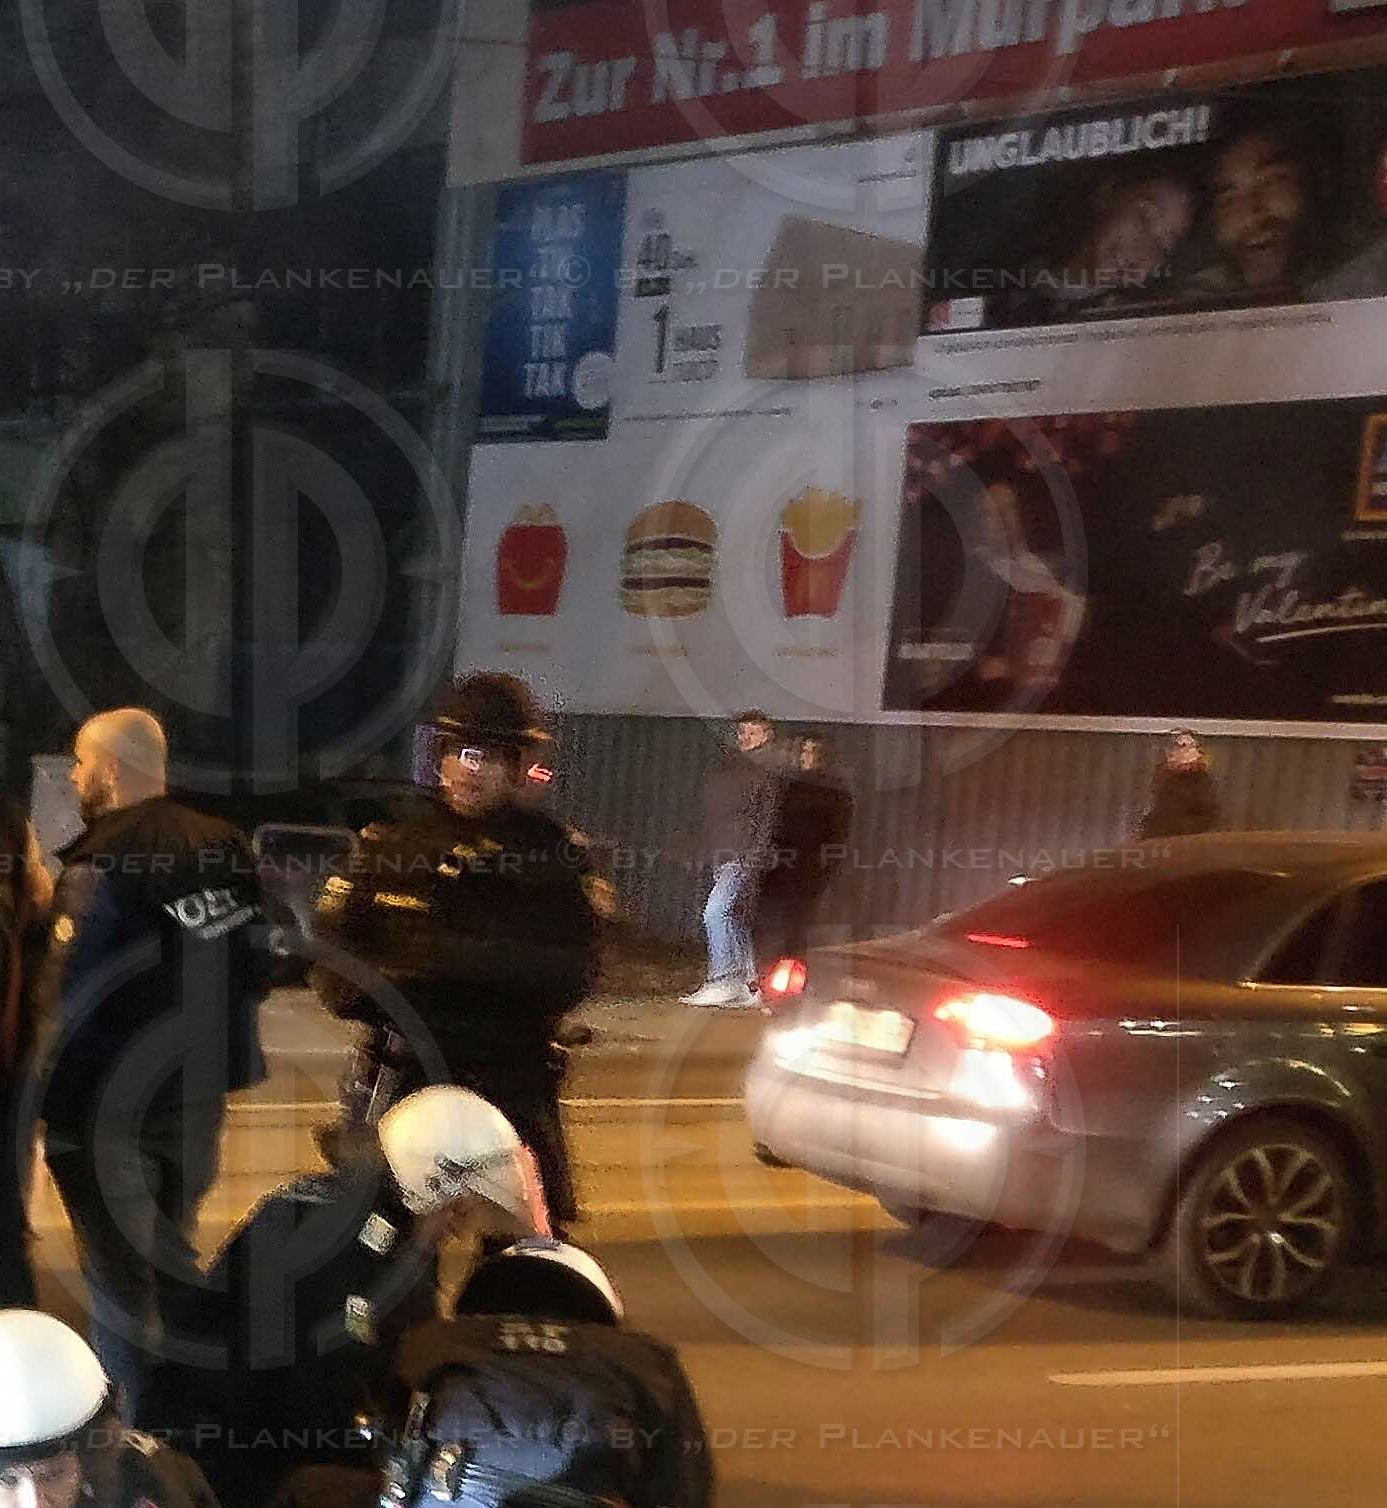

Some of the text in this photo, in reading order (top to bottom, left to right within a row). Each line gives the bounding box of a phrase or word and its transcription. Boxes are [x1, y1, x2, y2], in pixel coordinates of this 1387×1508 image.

[533, 50, 634, 125] Zur
[649, 14, 784, 108] Nr.1
[802, 5, 889, 79] im
[948, 104, 1212, 175] UNGLAUBLICH!
